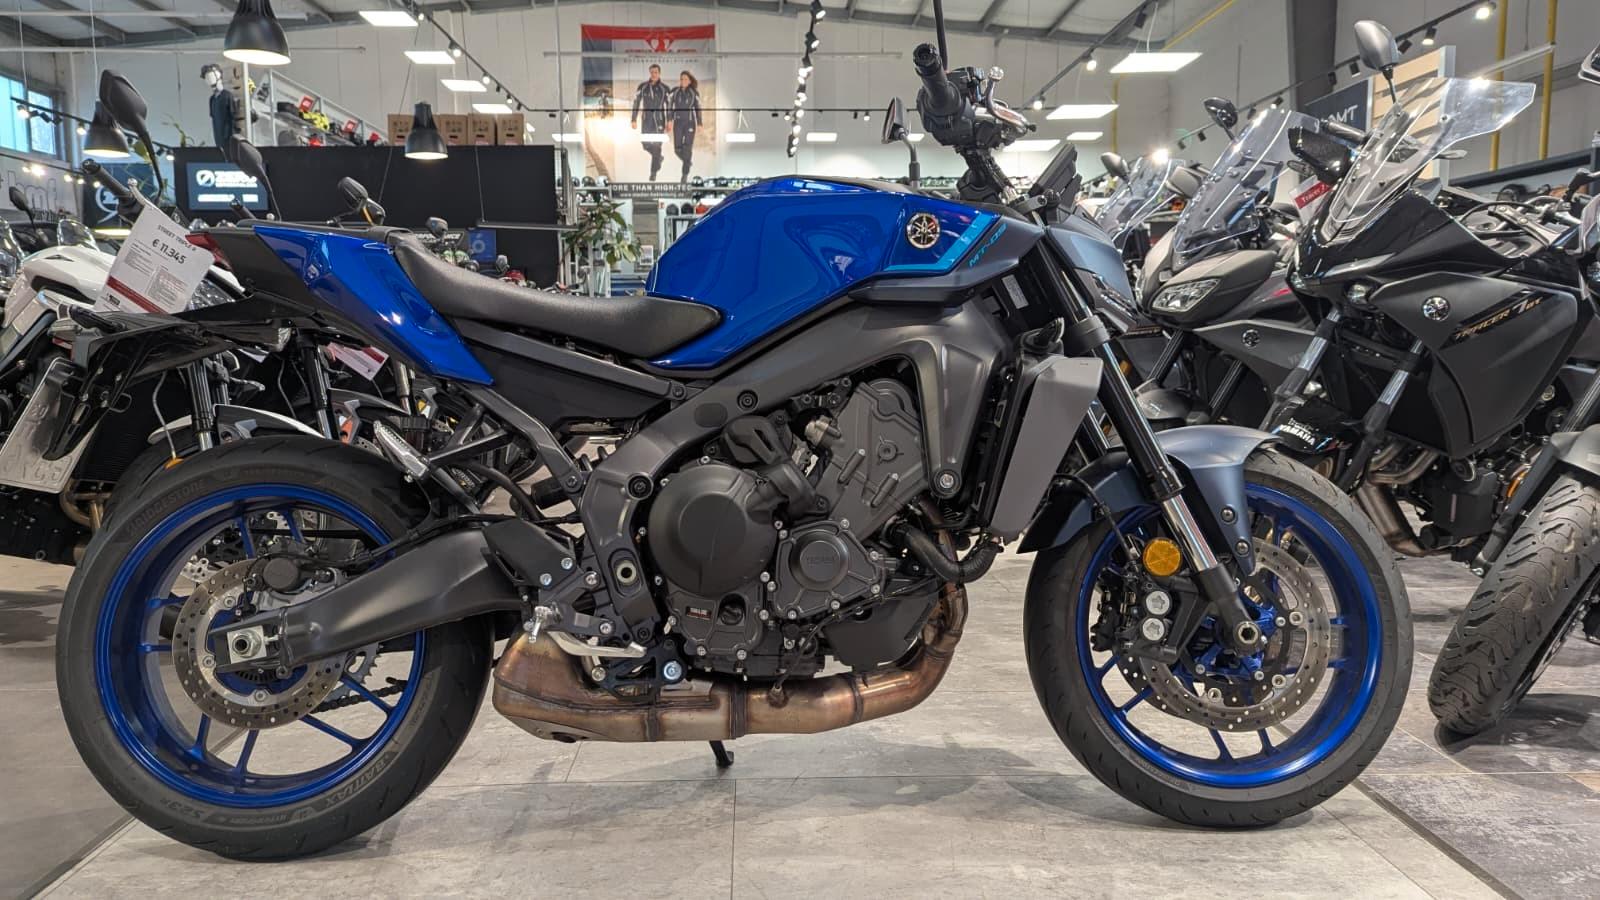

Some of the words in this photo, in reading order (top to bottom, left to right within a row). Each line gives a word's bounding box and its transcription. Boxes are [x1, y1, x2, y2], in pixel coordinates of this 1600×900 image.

[152, 239, 161, 248] €
[160, 242, 186, 264] 11.345
[968, 223, 1009, 268] MT-09
[1279, 424, 1316, 446] YAMAHA
